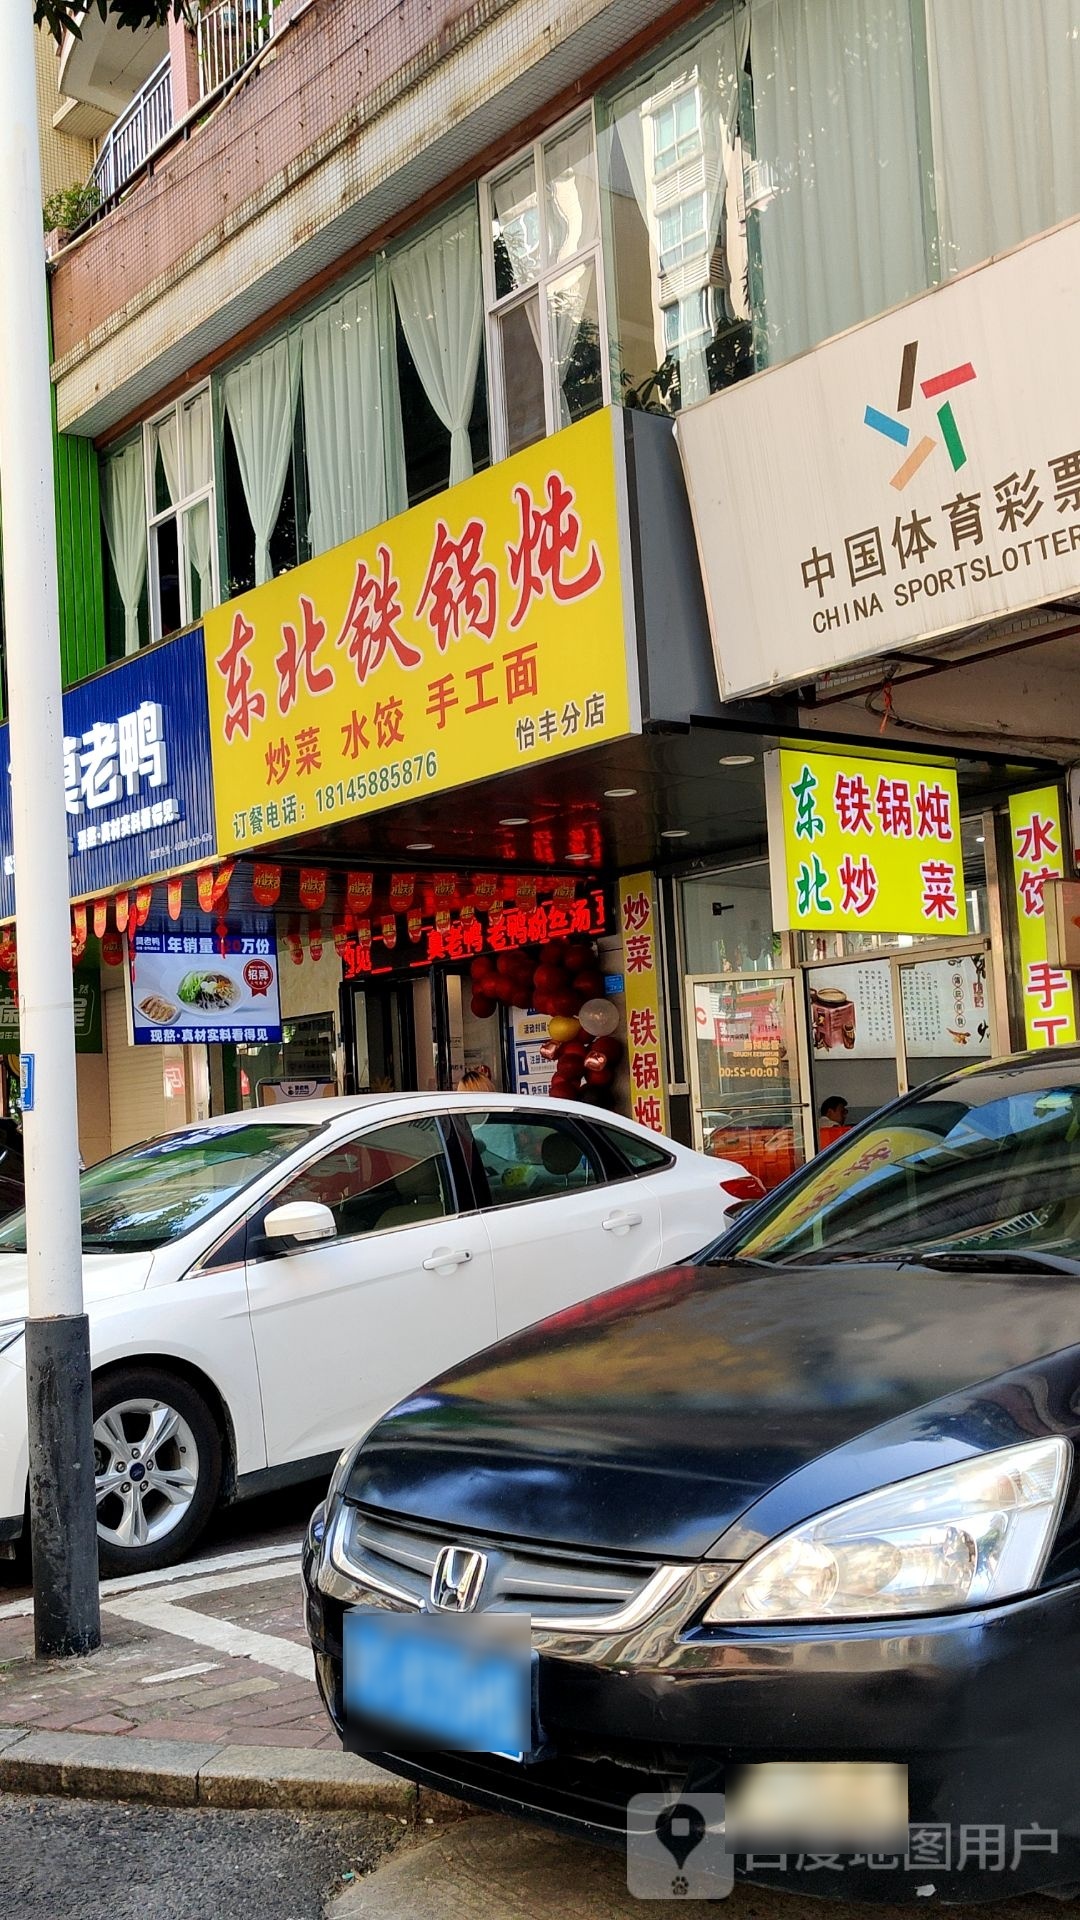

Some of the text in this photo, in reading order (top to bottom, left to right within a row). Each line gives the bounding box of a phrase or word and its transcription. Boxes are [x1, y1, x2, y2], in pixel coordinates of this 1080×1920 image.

[800, 449, 1080, 598] 中国体育彩票
[812, 523, 1080, 634] CHINA SPORTSLOTTER
[216, 474, 601, 740] 东北铁锅炖
[265, 643, 539, 786] 炒菜 水饺 手工面
[516, 693, 605, 751] 怡丰分店
[790, 766, 833, 915] 东北
[834, 773, 952, 841] 铁锅炖
[150, 1028, 268, 1043] 现熬·真材实料看得见
[248, 969, 269, 982] 招牌
[623, 893, 663, 1132] 炒菜 铁锅炖
